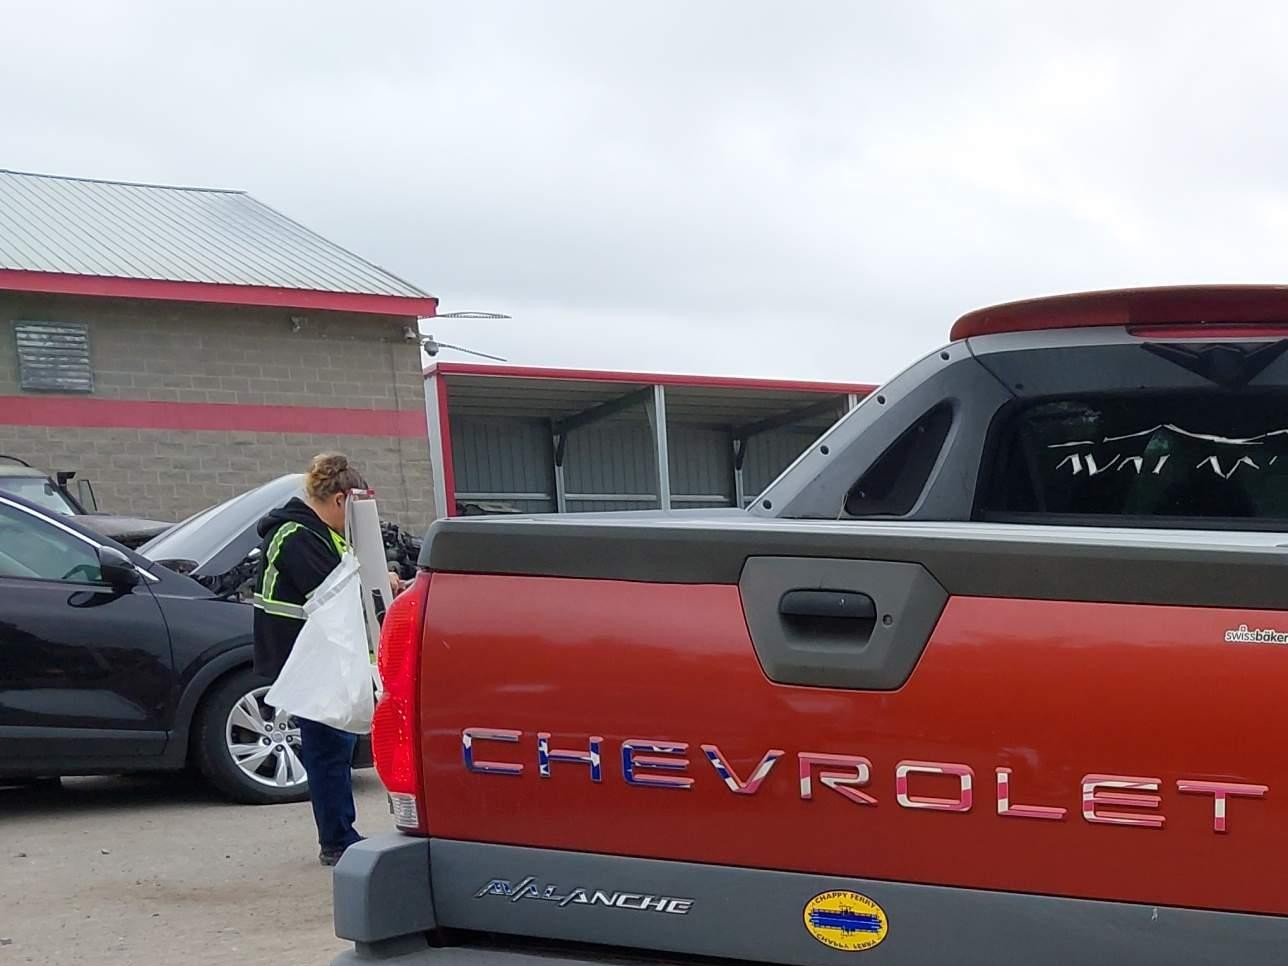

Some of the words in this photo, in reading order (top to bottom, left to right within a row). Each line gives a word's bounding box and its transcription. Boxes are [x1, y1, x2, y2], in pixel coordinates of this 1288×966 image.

[461, 726, 1269, 833] CHEVROLET
[475, 876, 696, 914] AVALANCHE
[815, 892, 848, 904] CHAPPY
[850, 893, 876, 908] FERRY
